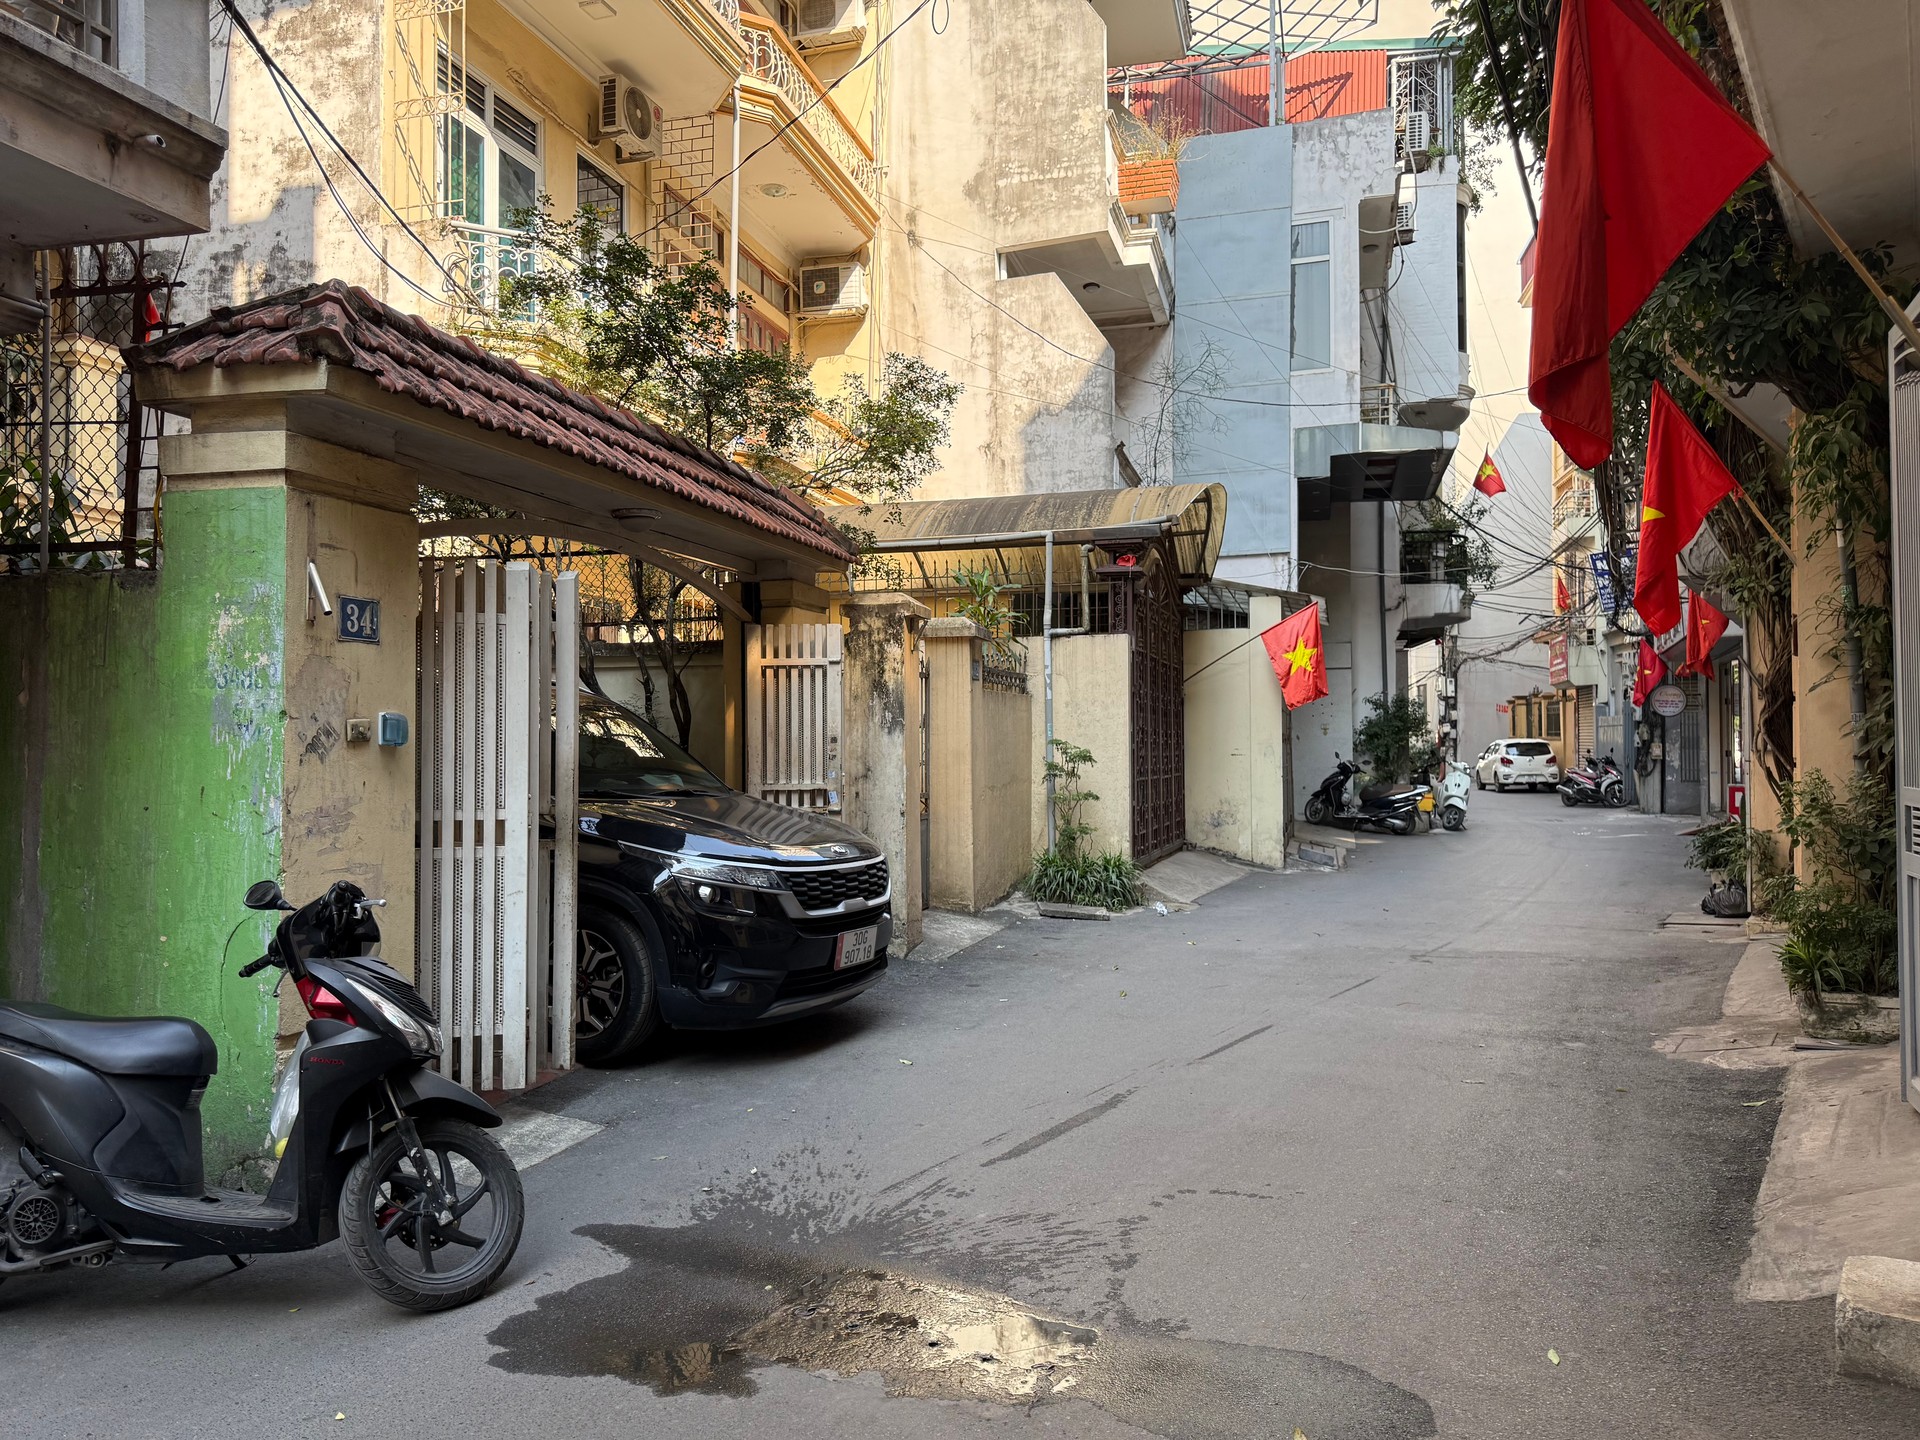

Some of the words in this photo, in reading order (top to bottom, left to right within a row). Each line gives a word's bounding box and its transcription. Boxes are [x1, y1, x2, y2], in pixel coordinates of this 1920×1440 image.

[346, 603, 373, 637] 34
[852, 930, 868, 947] 30G
[844, 944, 872, 965] 907.18
[309, 1056, 345, 1065] HONDA
